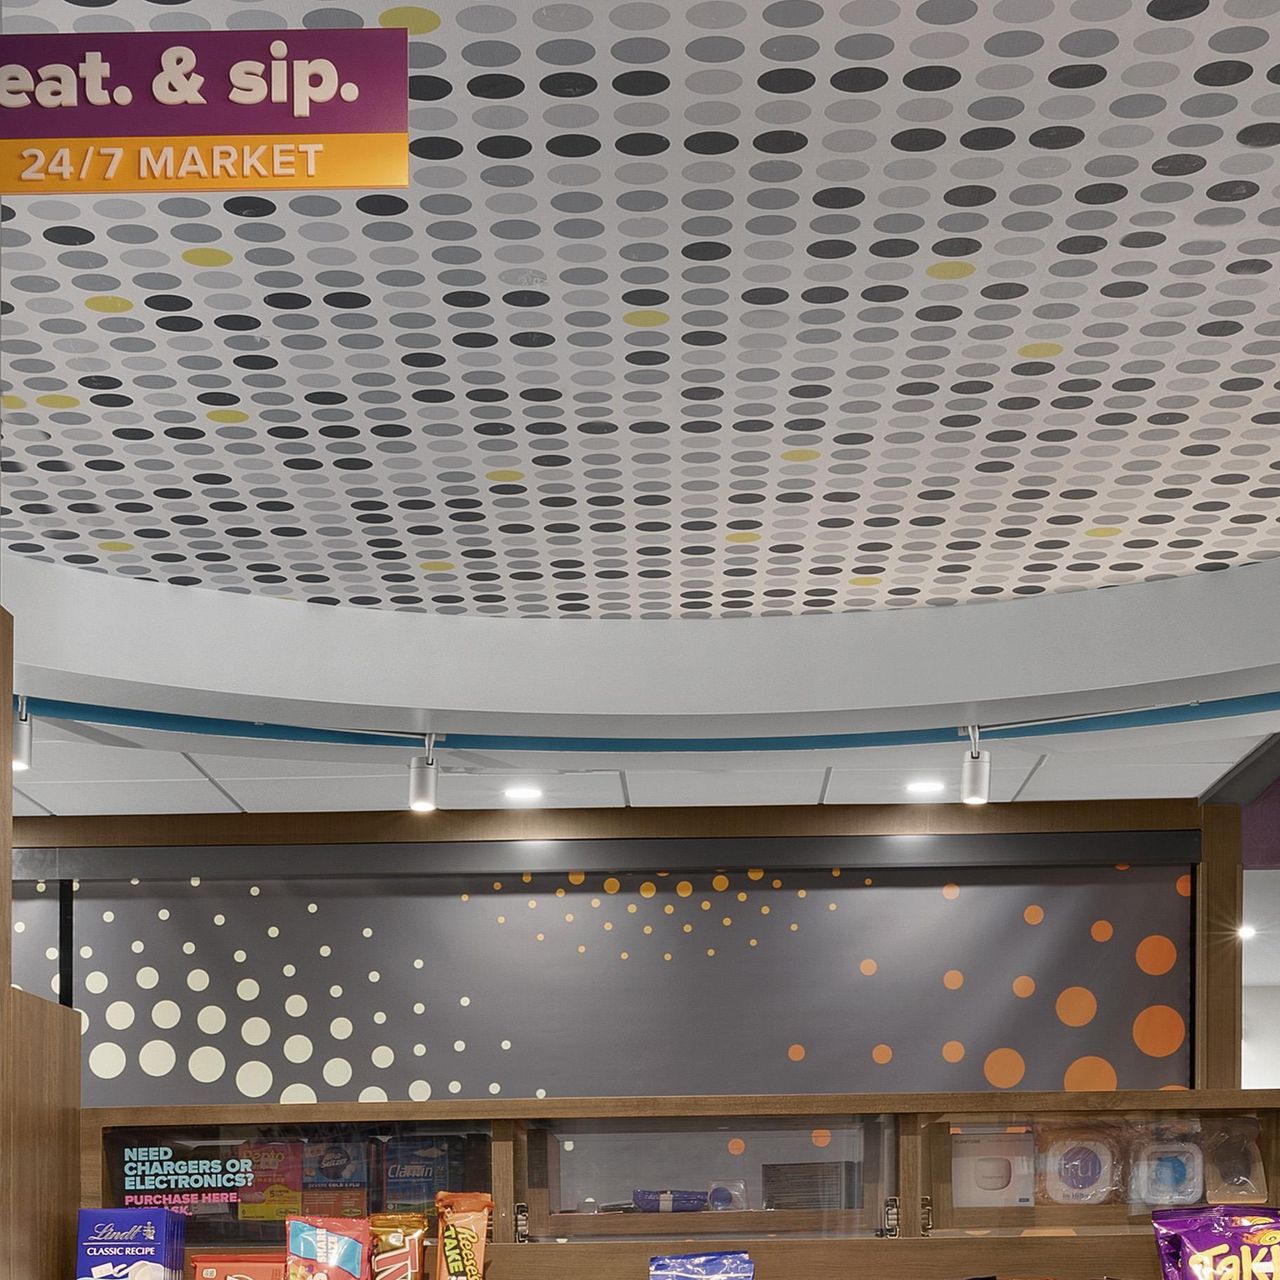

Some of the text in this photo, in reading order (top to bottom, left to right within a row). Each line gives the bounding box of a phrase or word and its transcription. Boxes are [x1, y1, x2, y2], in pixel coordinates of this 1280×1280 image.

[152, 46, 207, 105] &
[229, 40, 360, 118] sip.
[20, 143, 324, 181] 24/7 MARKET
[124, 1147, 173, 1161] NEED
[124, 1159, 252, 1176] CHARGERS OR
[124, 1173, 255, 1190] ELECTRONICS?
[125, 1192, 241, 1205] PURCHASE HERE.
[88, 1223, 142, 1241] Lindt
[87, 1247, 155, 1256] CLASSIC RECIPE
[444, 1228, 460, 1274] TAKE
